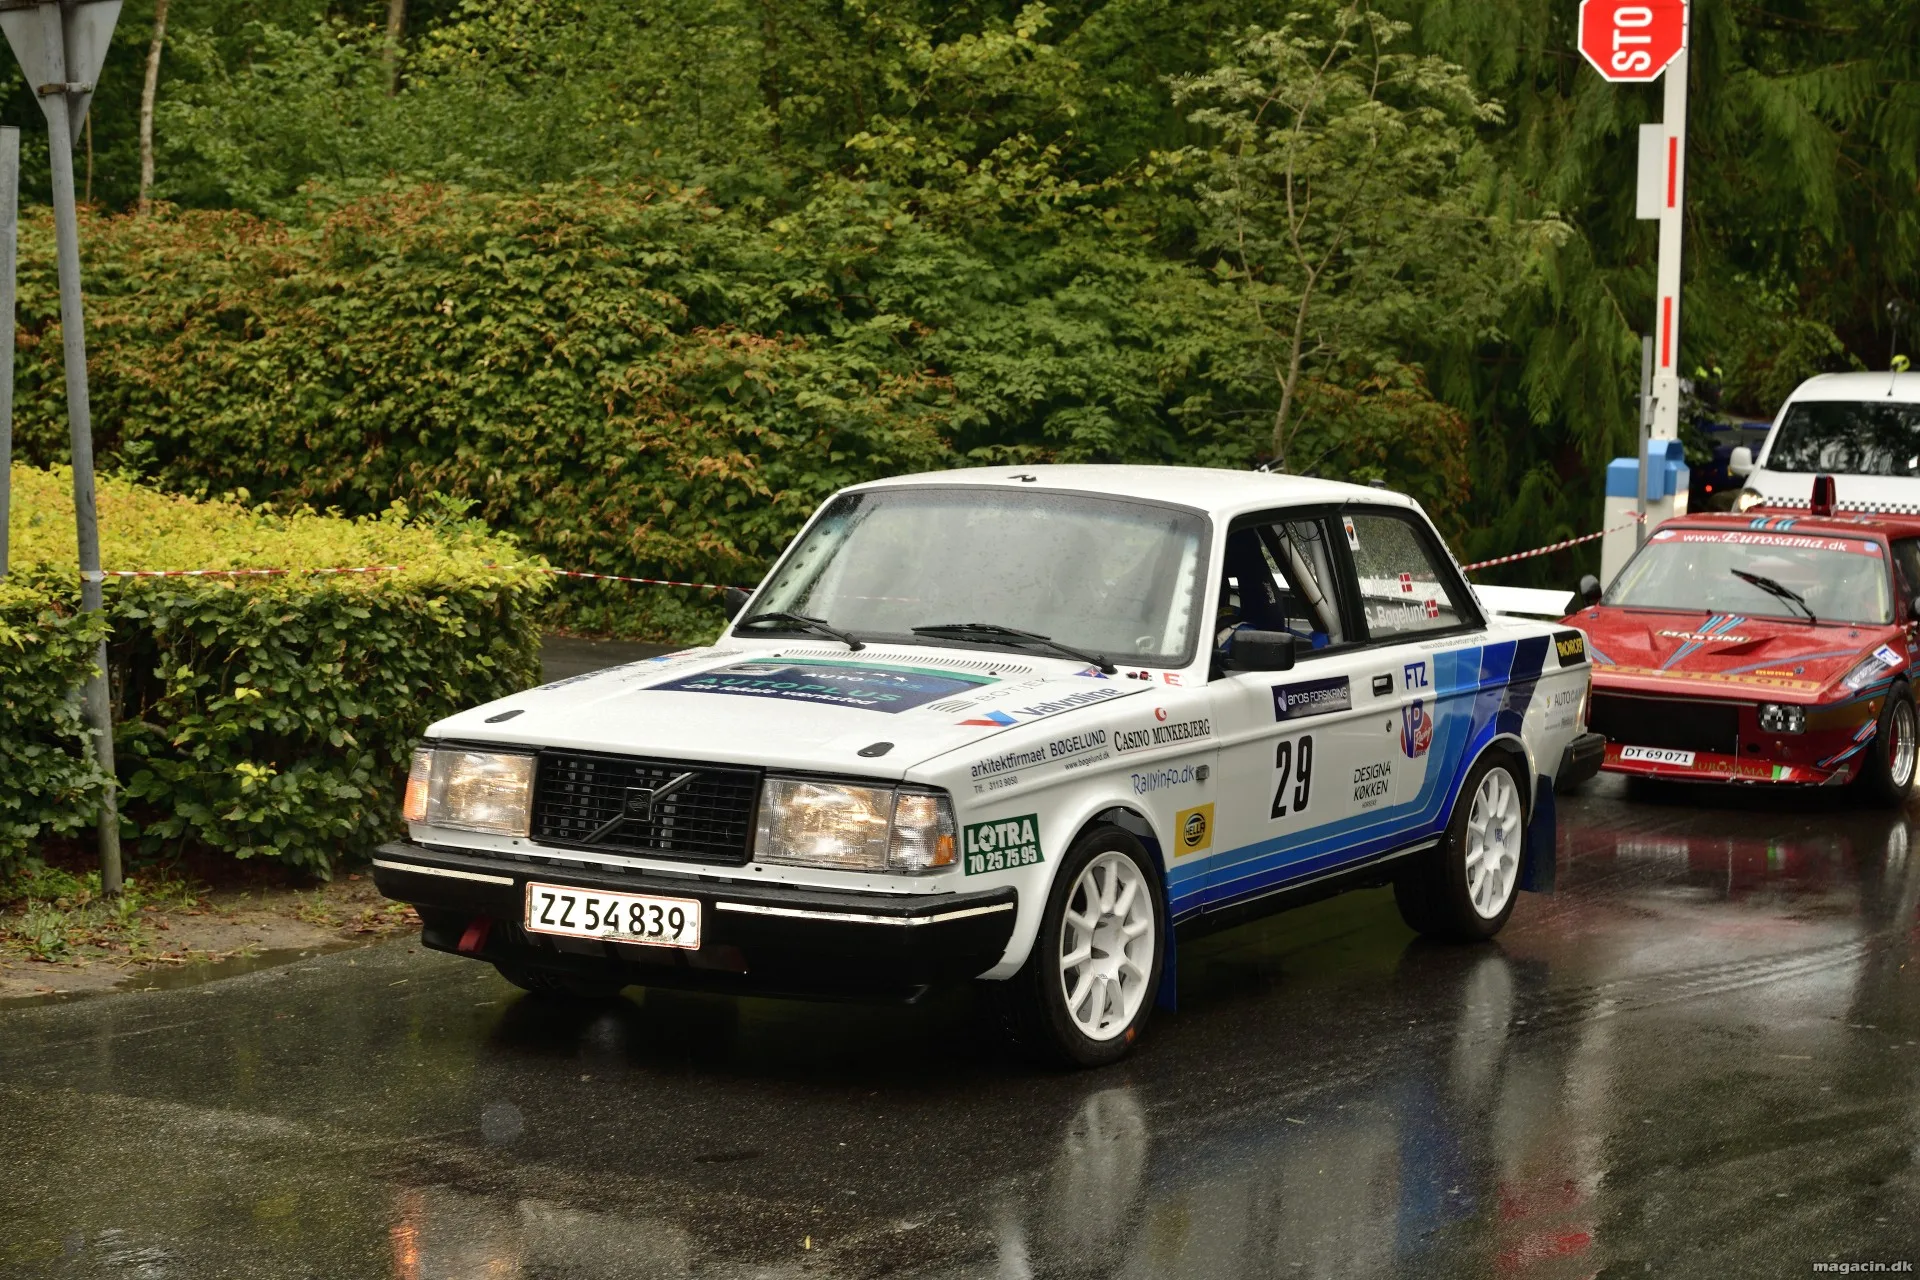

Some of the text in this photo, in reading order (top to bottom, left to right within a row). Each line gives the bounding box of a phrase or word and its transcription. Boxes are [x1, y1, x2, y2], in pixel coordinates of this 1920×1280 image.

[1611, 6, 1653, 72] STO
[1683, 531, 1848, 552] www.Eurosama.dk
[1661, 630, 1746, 642] MARTINI
[690, 678, 901, 701] AUTOPLUS
[1404, 661, 1428, 690] FTZ
[1012, 688, 1125, 717] Valvoline
[1287, 692, 1310, 706] aros
[1114, 718, 1210, 752] CASINO MUNKEBJERG
[1401, 698, 1424, 759] VP
[971, 729, 1107, 778] arkitektfirmaet BØGELUND
[1624, 747, 1644, 758] DT
[1646, 749, 1662, 760] 69
[1664, 751, 1688, 763] 071
[1131, 765, 1195, 796] Rallyinfo.dk
[1271, 734, 1313, 820] 29
[1353, 778, 1389, 802] KØKKEN
[967, 819, 1036, 854] LOTRA
[1185, 821, 1205, 837] HELLA
[968, 844, 1038, 874] 70 25 75 95
[540, 893, 686, 940] ZZ 54 839
